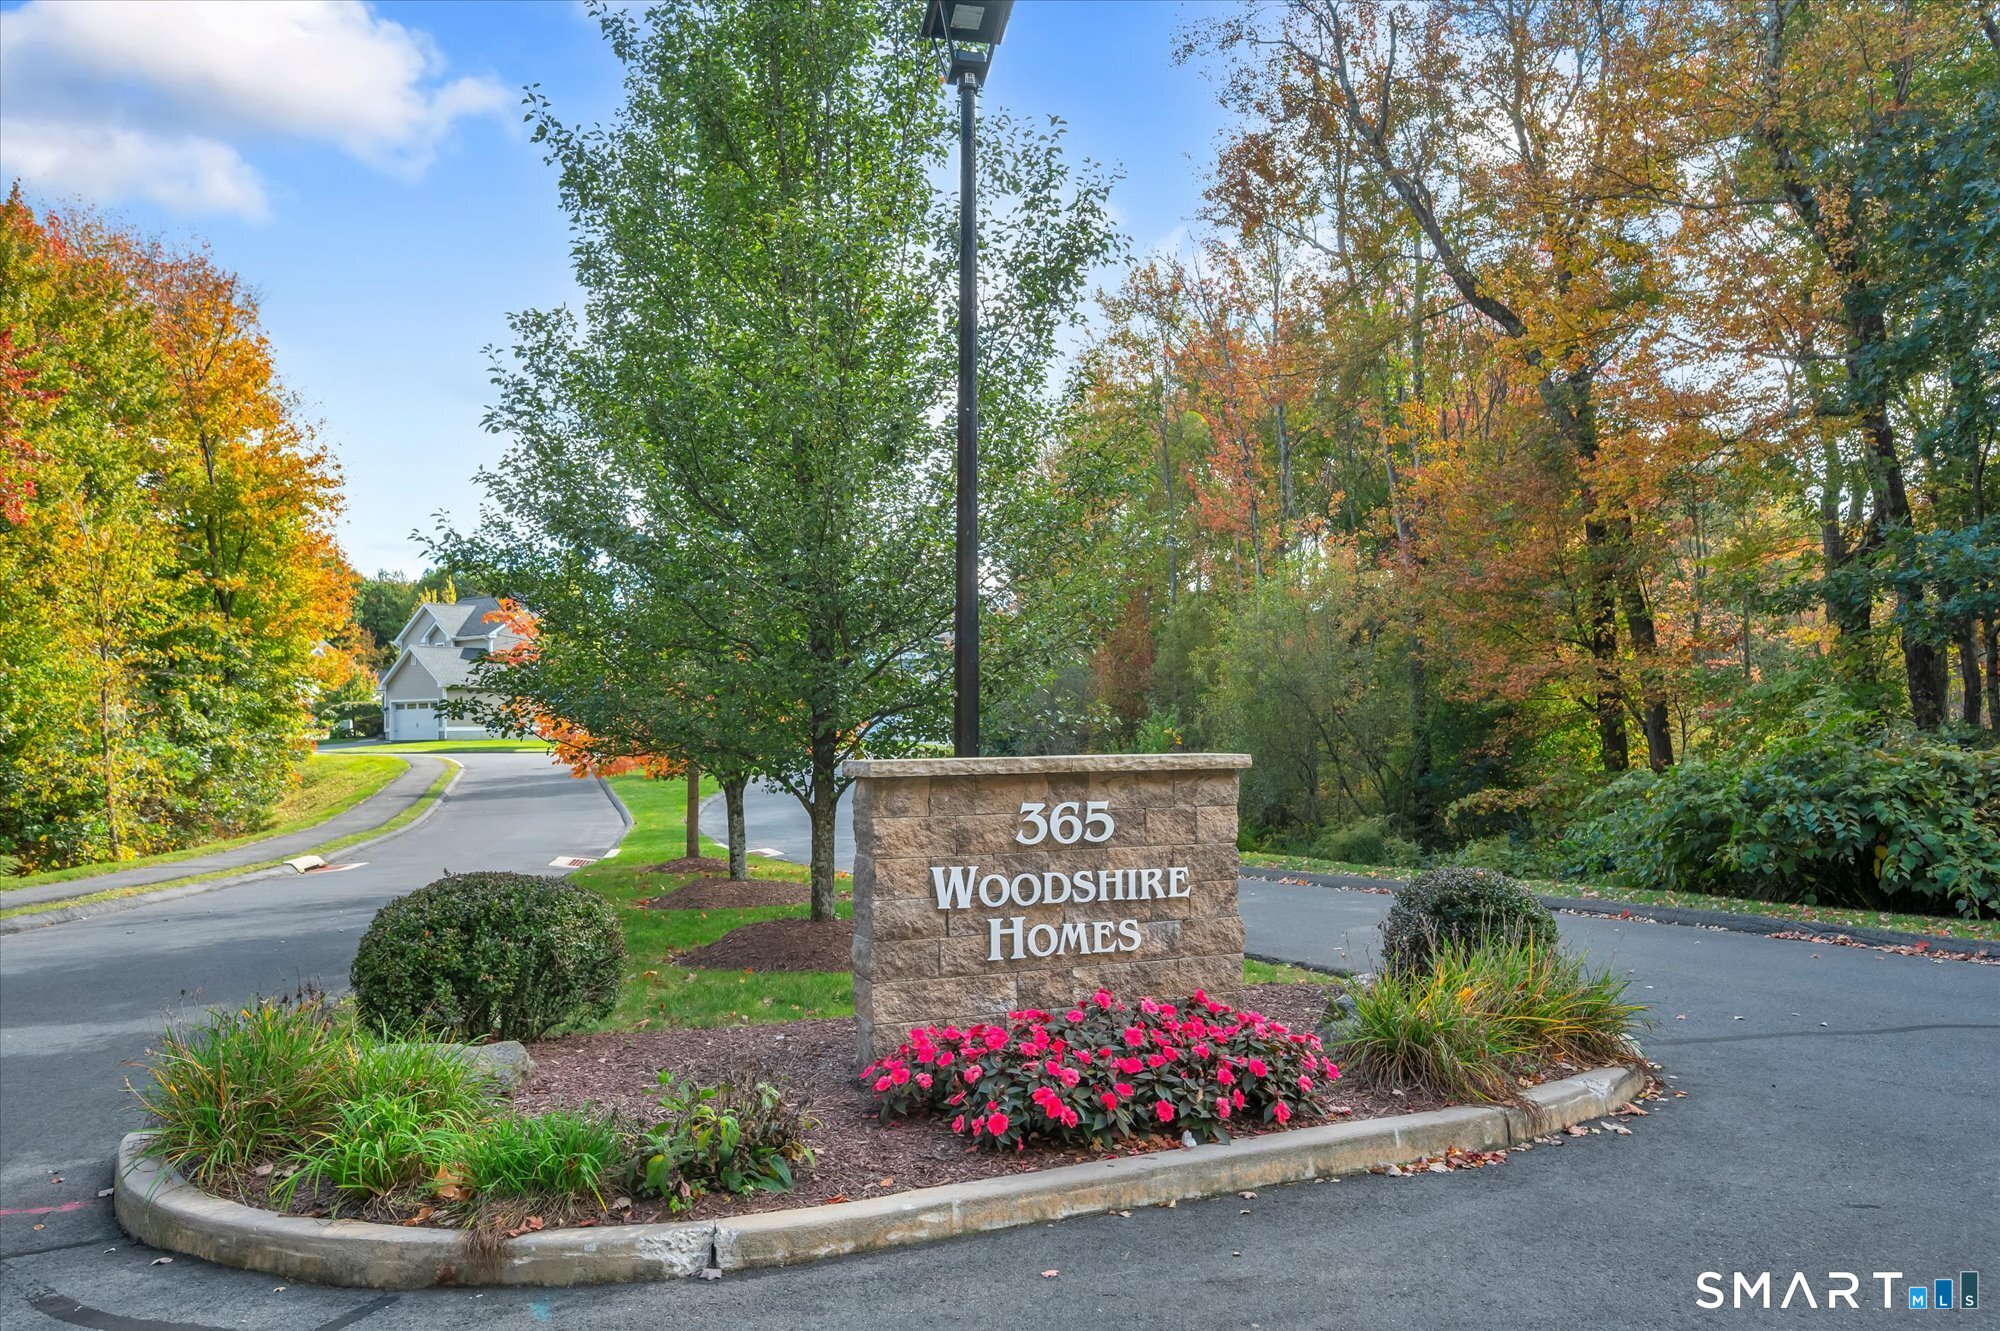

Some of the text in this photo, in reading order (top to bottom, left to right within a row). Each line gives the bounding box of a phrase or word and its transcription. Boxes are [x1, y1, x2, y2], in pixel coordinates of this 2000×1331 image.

[1015, 800, 1115, 845] 365
[930, 865, 1192, 910] WOODSHIRE
[987, 916, 1142, 961] HOMES
